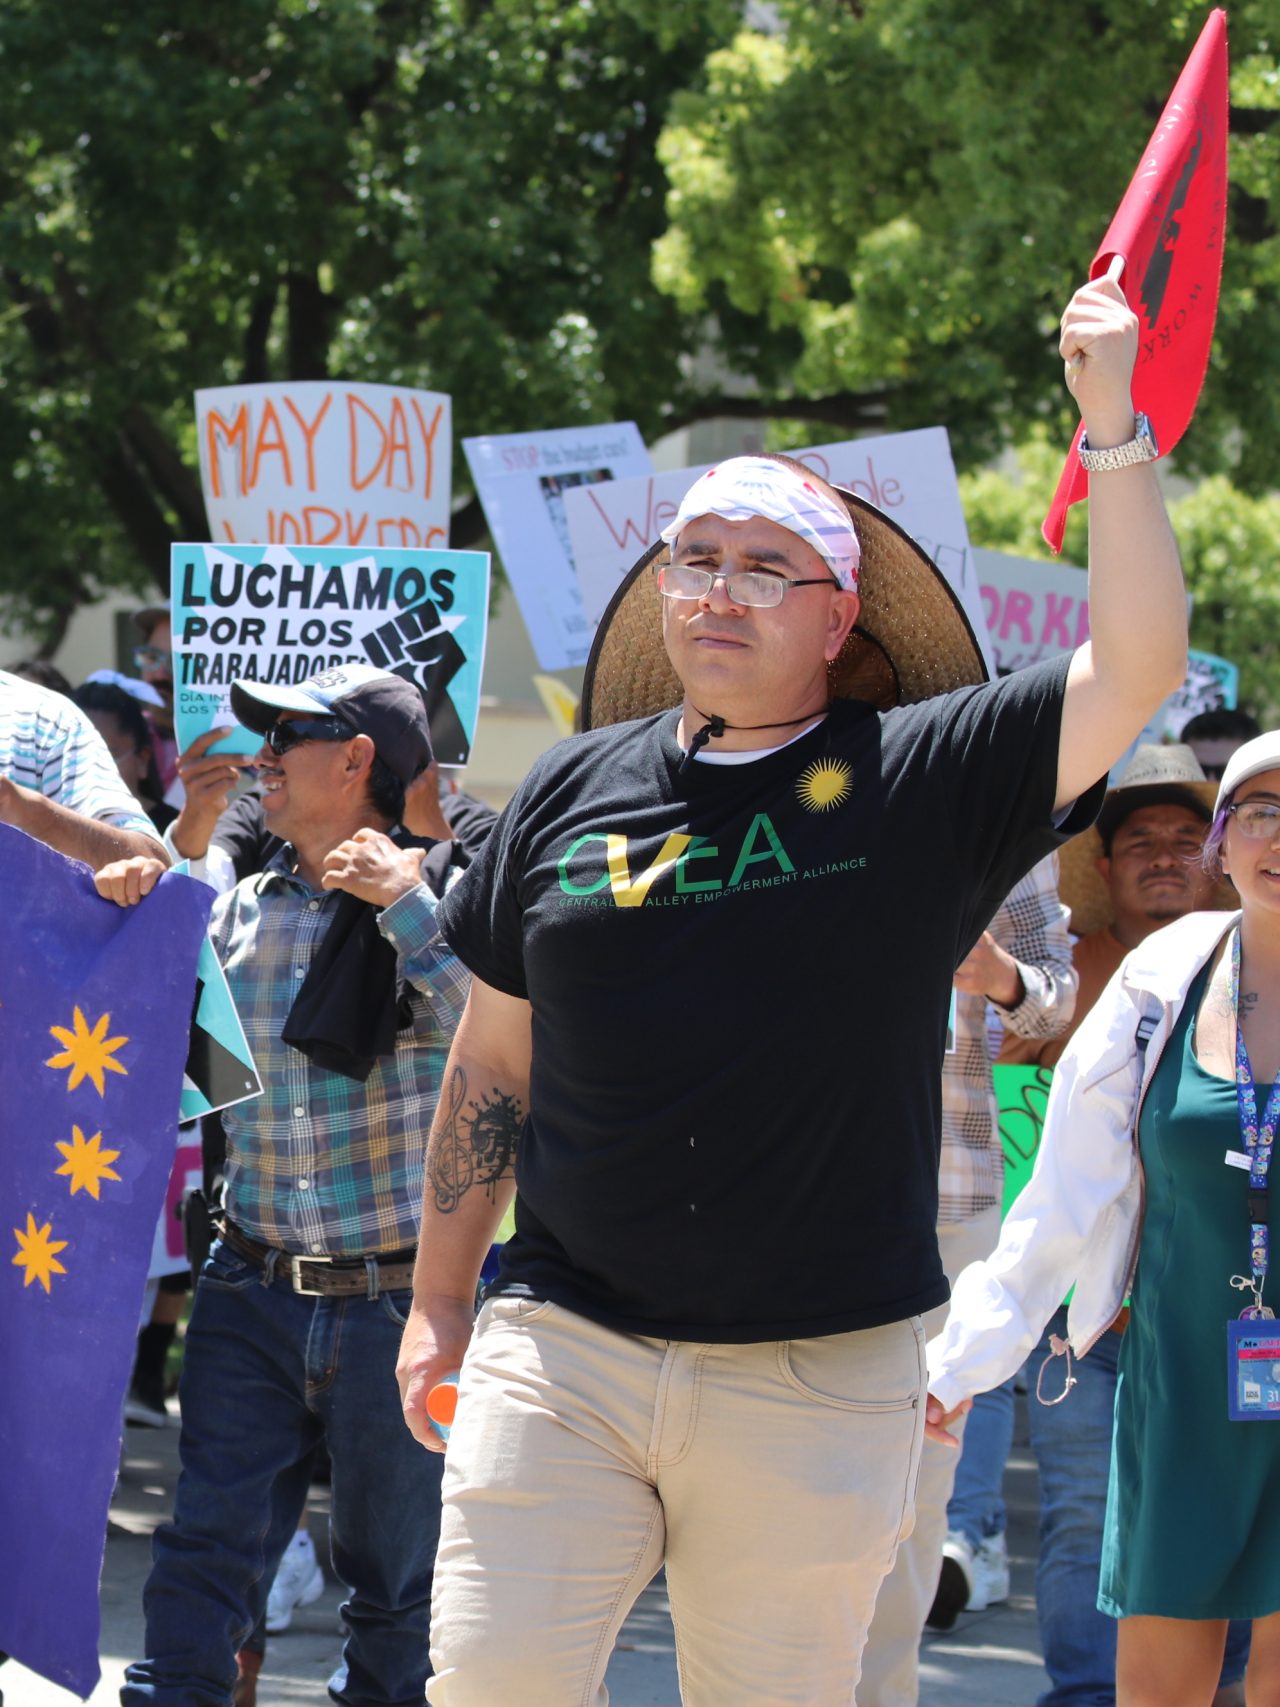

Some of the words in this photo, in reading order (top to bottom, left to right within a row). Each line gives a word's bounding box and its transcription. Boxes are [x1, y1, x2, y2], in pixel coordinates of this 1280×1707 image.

[207, 393, 333, 497] MAY
[347, 393, 442, 499] DAY
[587, 478, 678, 549] We
[181, 563, 456, 612] LUCHAMOS
[182, 616, 266, 646] POR
[277, 619, 353, 647] LOS
[180, 691, 206, 702] DÍA
[181, 705, 209, 714] LOS
[557, 813, 796, 907] CVEA
[695, 872, 798, 904] EMPOWERMENT
[802, 857, 867, 880] ALLIANCE
